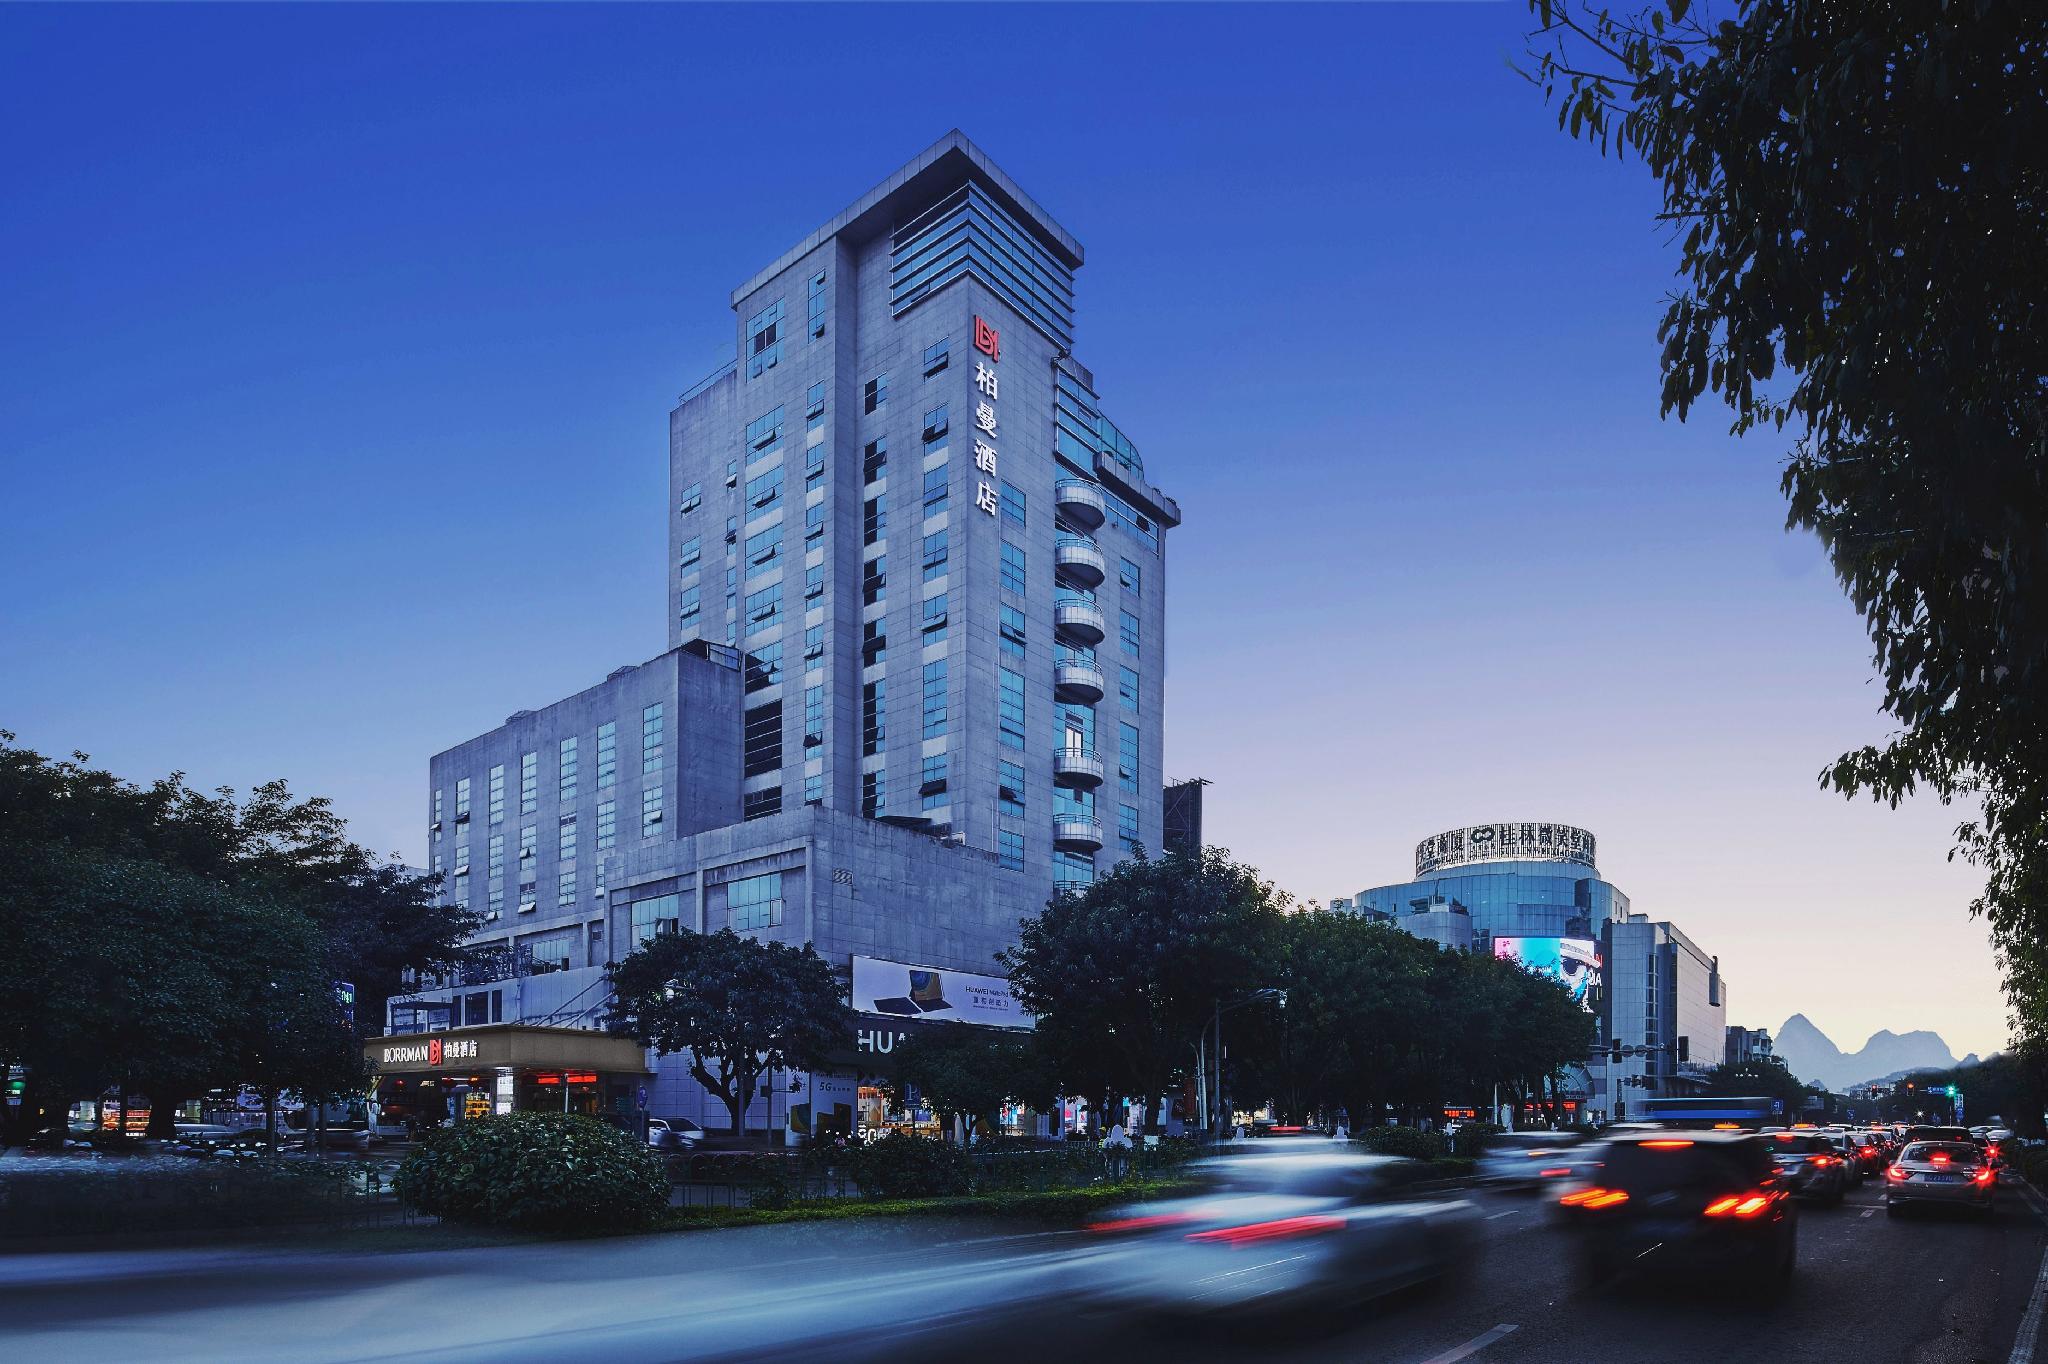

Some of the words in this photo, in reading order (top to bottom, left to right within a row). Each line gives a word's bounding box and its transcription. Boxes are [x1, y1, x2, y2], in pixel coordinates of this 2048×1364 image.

[974, 362, 999, 516] 柏曼酒店
[965, 985, 989, 995] HUAWEI
[383, 1045, 429, 1063] BORRMAN
[443, 1039, 478, 1059] 柏曼酒店
[819, 1081, 833, 1092] 5G
